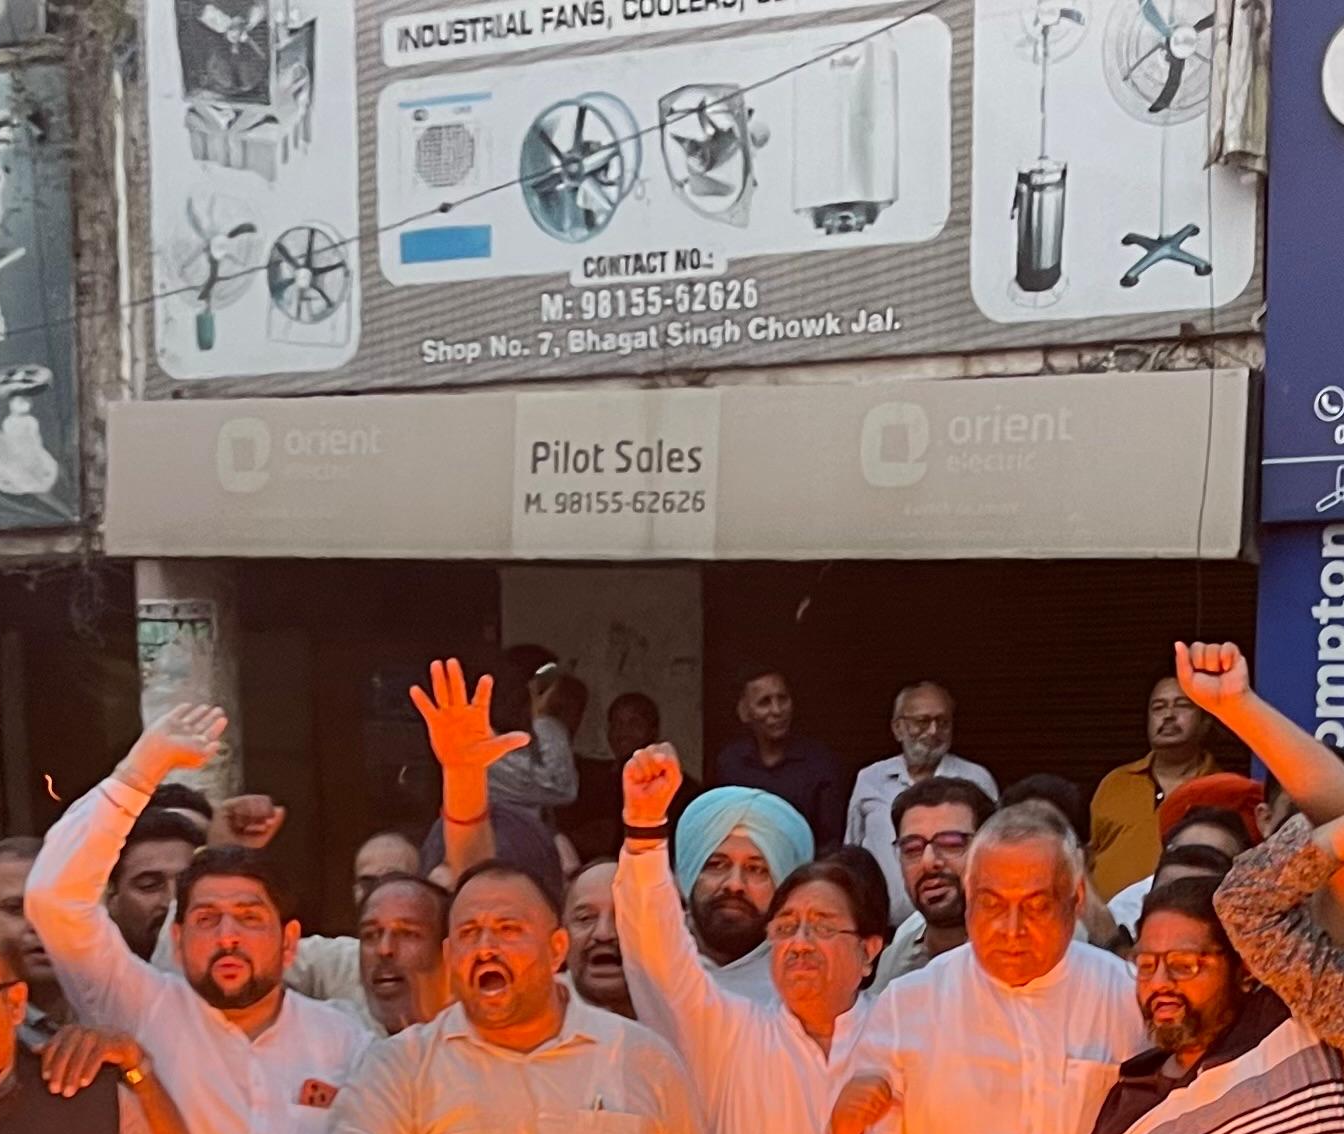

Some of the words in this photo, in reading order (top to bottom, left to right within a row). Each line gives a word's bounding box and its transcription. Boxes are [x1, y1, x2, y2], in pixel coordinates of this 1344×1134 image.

[398, 13, 533, 53] INDUSTRIAL
[541, 0, 612, 33] FANS,
[583, 251, 668, 278] CONTACT
[541, 293, 573, 322] M:
[581, 278, 757, 321] 98155-62626
[422, 339, 482, 363] Shop
[490, 334, 530, 357] No.
[537, 332, 560, 358] 7,
[567, 325, 659, 355] Bhagat
[666, 319, 741, 349] Singh
[747, 312, 841, 341] Chowk
[851, 307, 901, 333] Jal.
[947, 405, 1073, 445] orient
[531, 440, 605, 474] Pilot
[615, 438, 703, 474] Sales
[555, 489, 707, 515] 98155-62626
